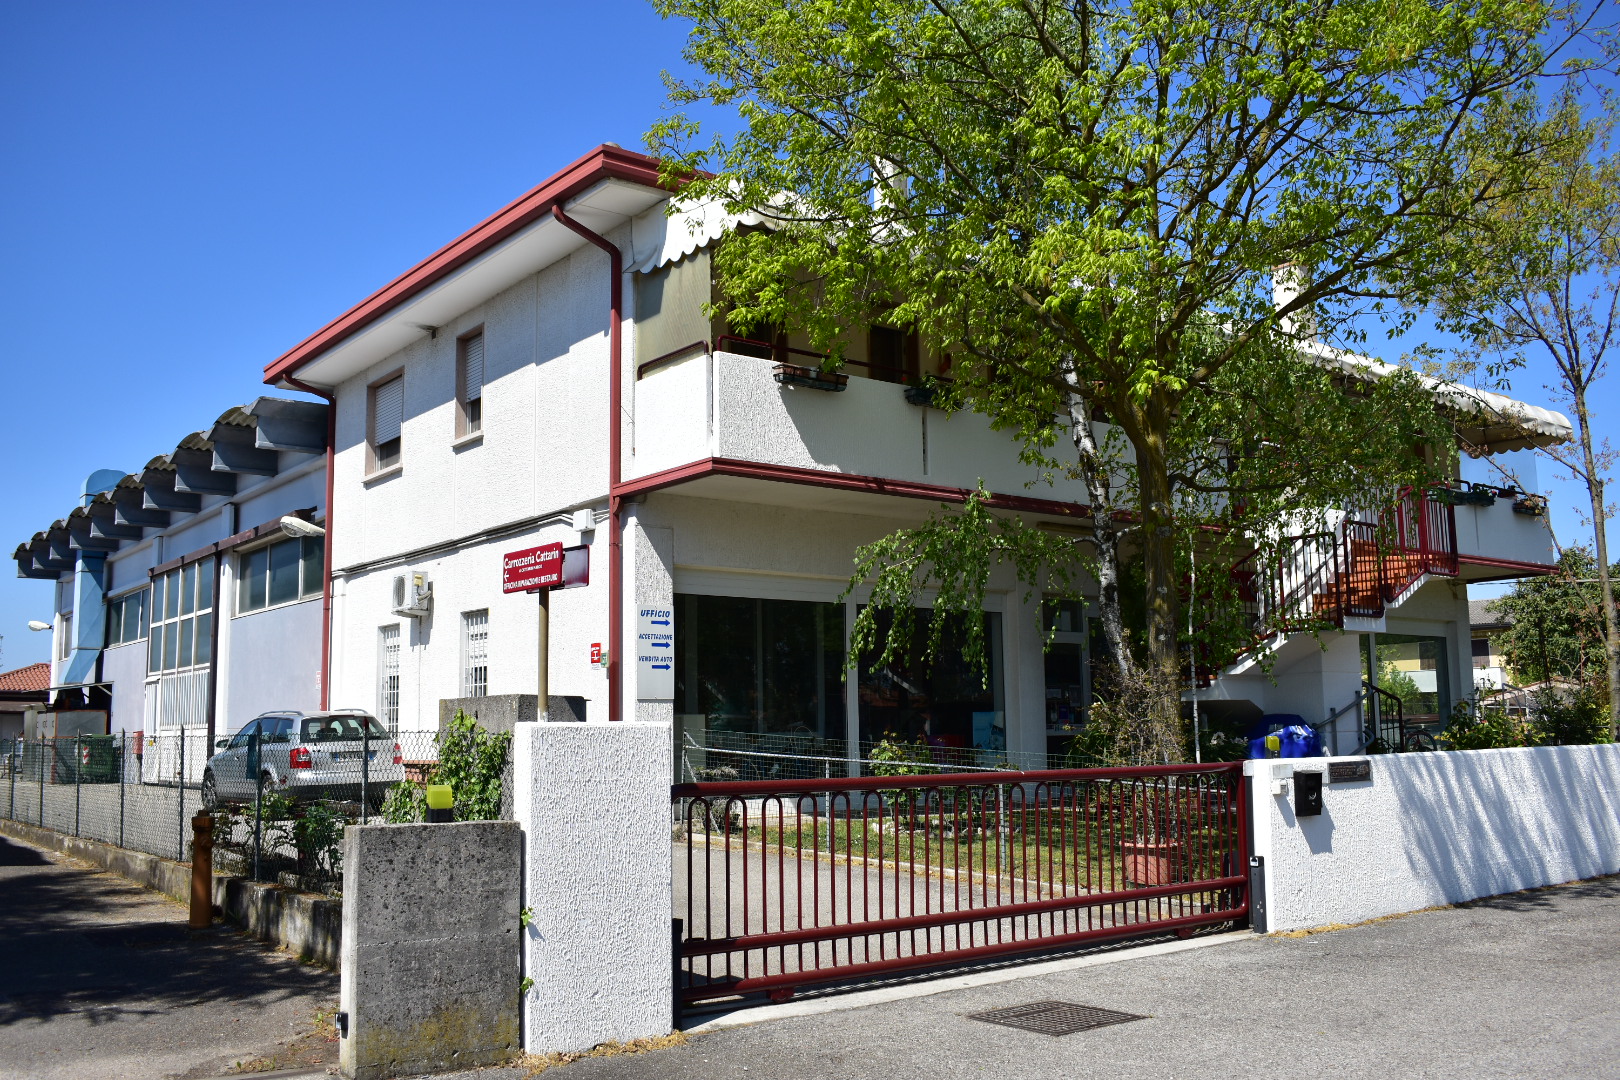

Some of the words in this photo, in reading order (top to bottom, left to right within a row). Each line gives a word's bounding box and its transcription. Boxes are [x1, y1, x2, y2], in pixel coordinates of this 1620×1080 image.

[504, 553, 534, 569] Carrozzeria
[536, 548, 558, 562] Cattarin
[640, 610, 670, 618] UFFICIO
